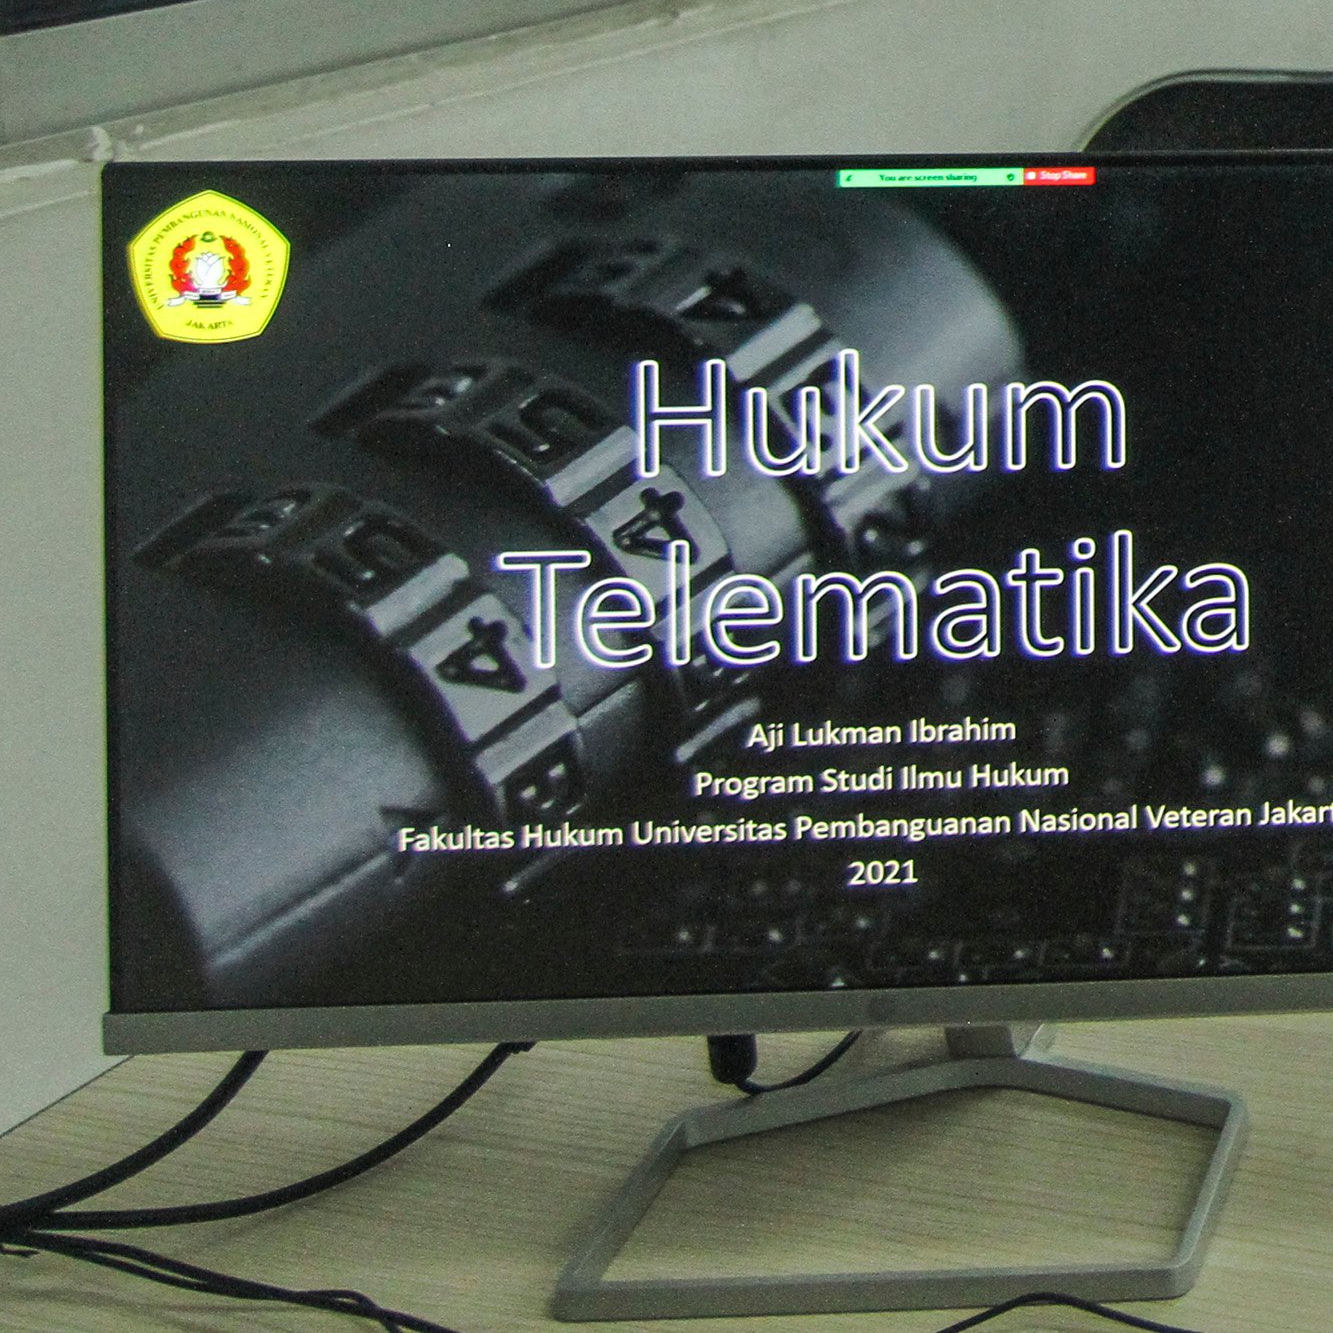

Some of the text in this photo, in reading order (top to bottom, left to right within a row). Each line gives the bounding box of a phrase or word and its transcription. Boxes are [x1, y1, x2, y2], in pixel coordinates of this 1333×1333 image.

[945, 173, 978, 183] sharing
[1039, 170, 1089, 181] Stop Share
[632, 349, 1127, 478] Hukum
[496, 530, 1251, 668] Telematika
[746, 716, 1017, 752] Aji Lukman Ibrahim
[694, 761, 1069, 800] Program Studi Ilmu Hukum
[397, 824, 515, 852] Fakultas
[521, 821, 623, 849] Hukum
[631, 817, 787, 847] Universitas
[794, 812, 1011, 842] Pembanguanan
[1019, 804, 1138, 834] Nasional
[1144, 804, 1252, 830] Veteran
[847, 859, 919, 886] 2021
